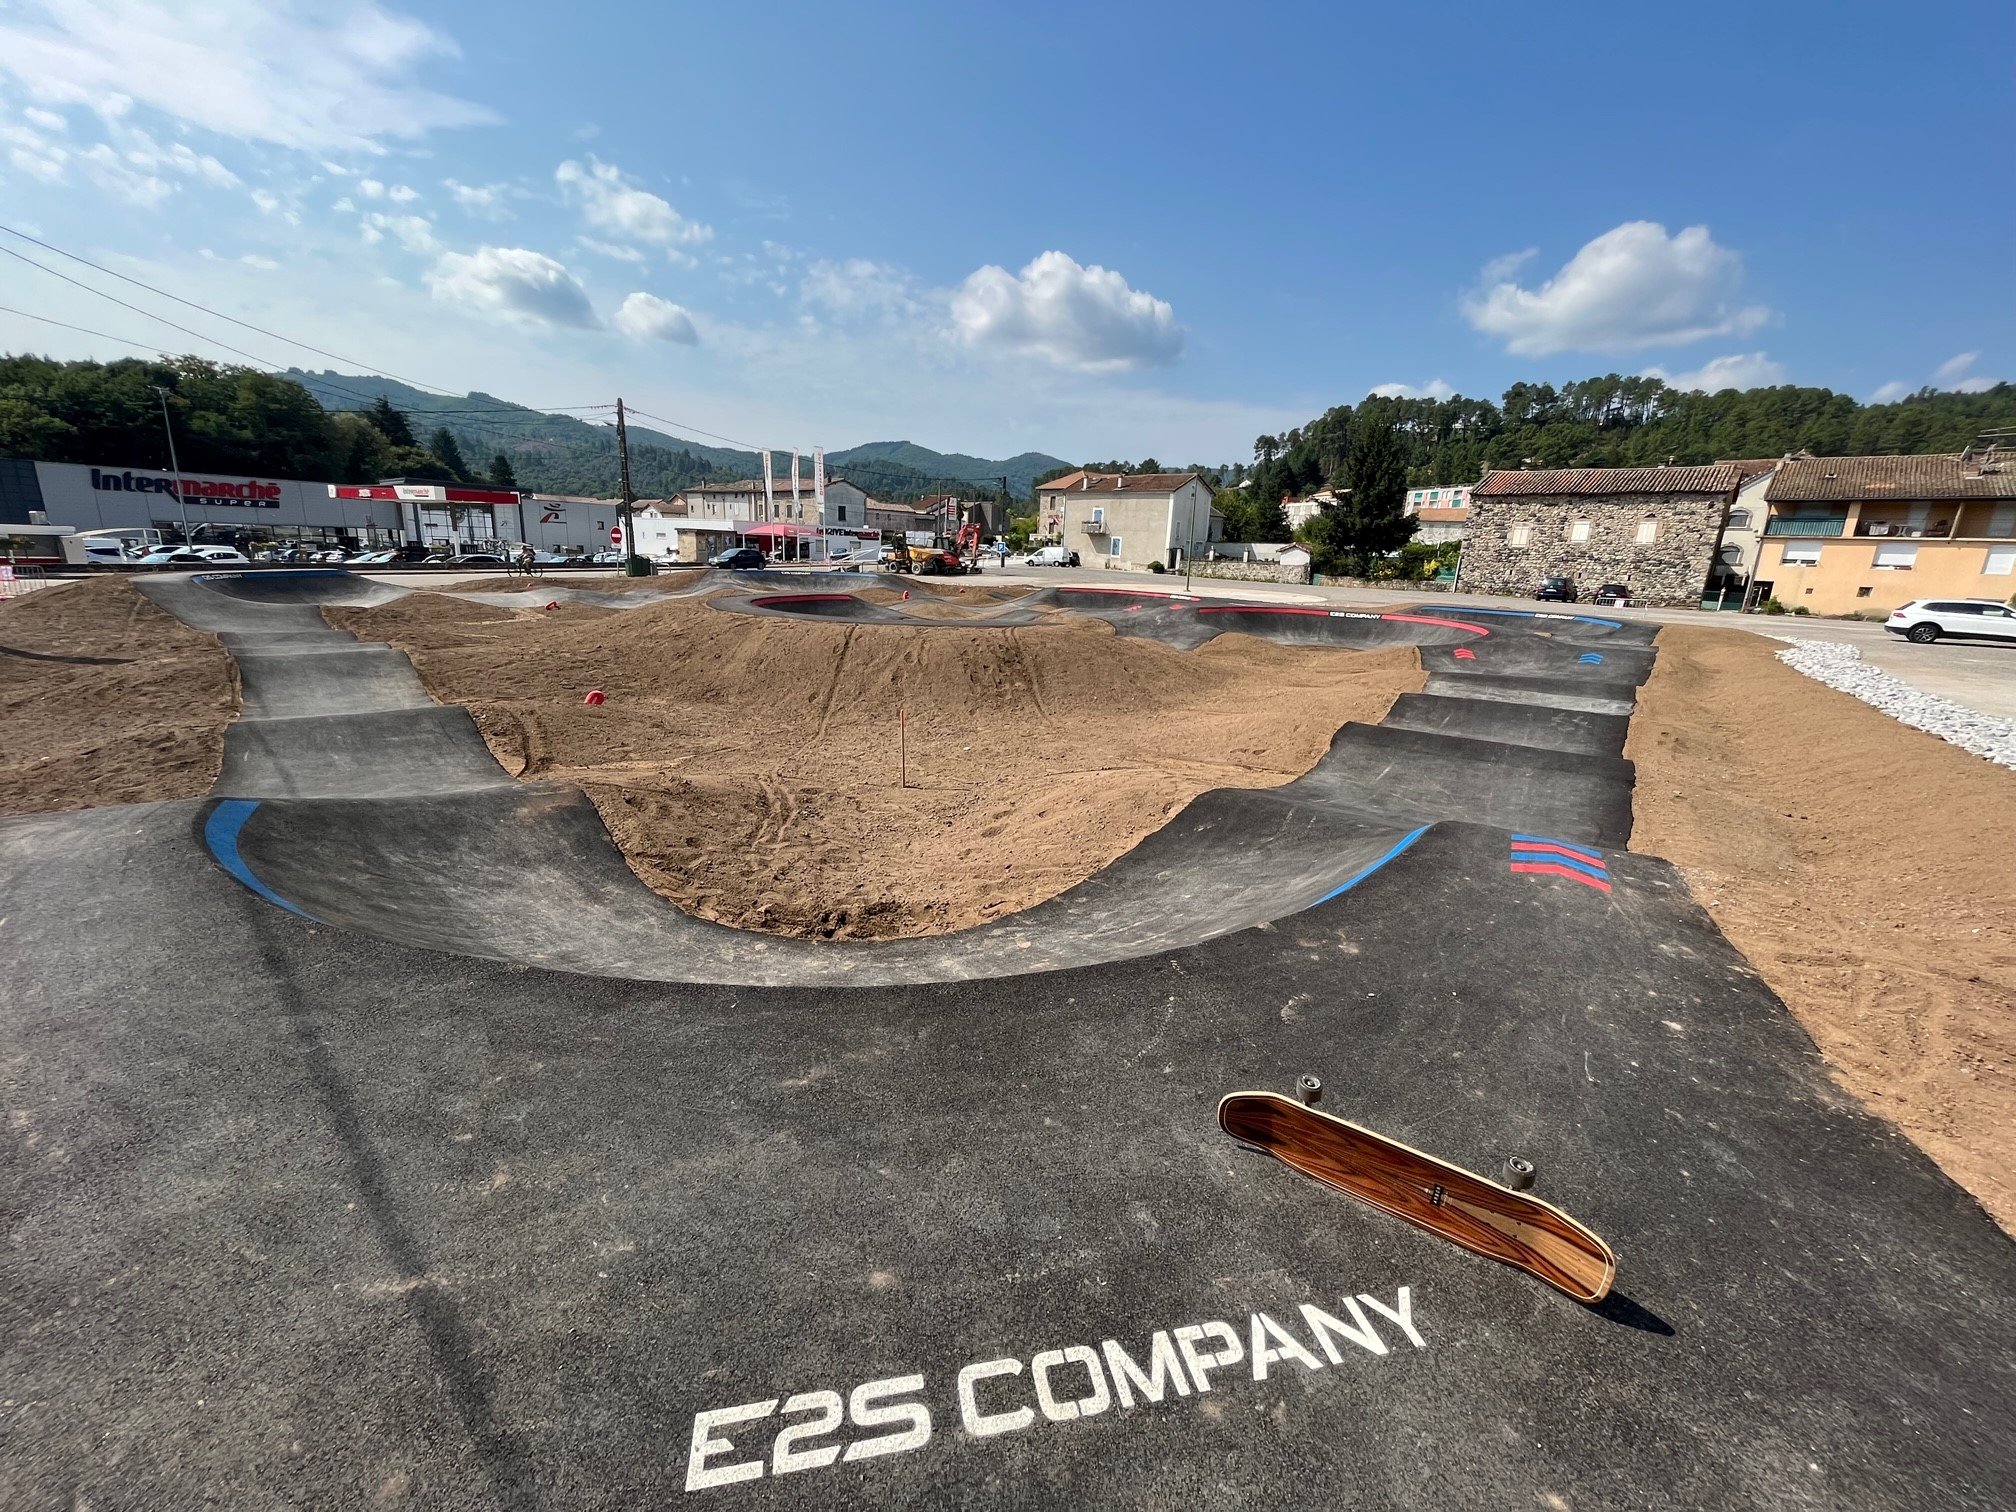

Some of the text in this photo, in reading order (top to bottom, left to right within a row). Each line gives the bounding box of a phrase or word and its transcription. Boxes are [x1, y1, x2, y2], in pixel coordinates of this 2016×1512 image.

[91, 468, 281, 500] Intermarché
[200, 497, 266, 507] SUPER
[1345, 612, 1381, 620] COMPANY
[685, 1286, 1427, 1492] E2S COMPANY
